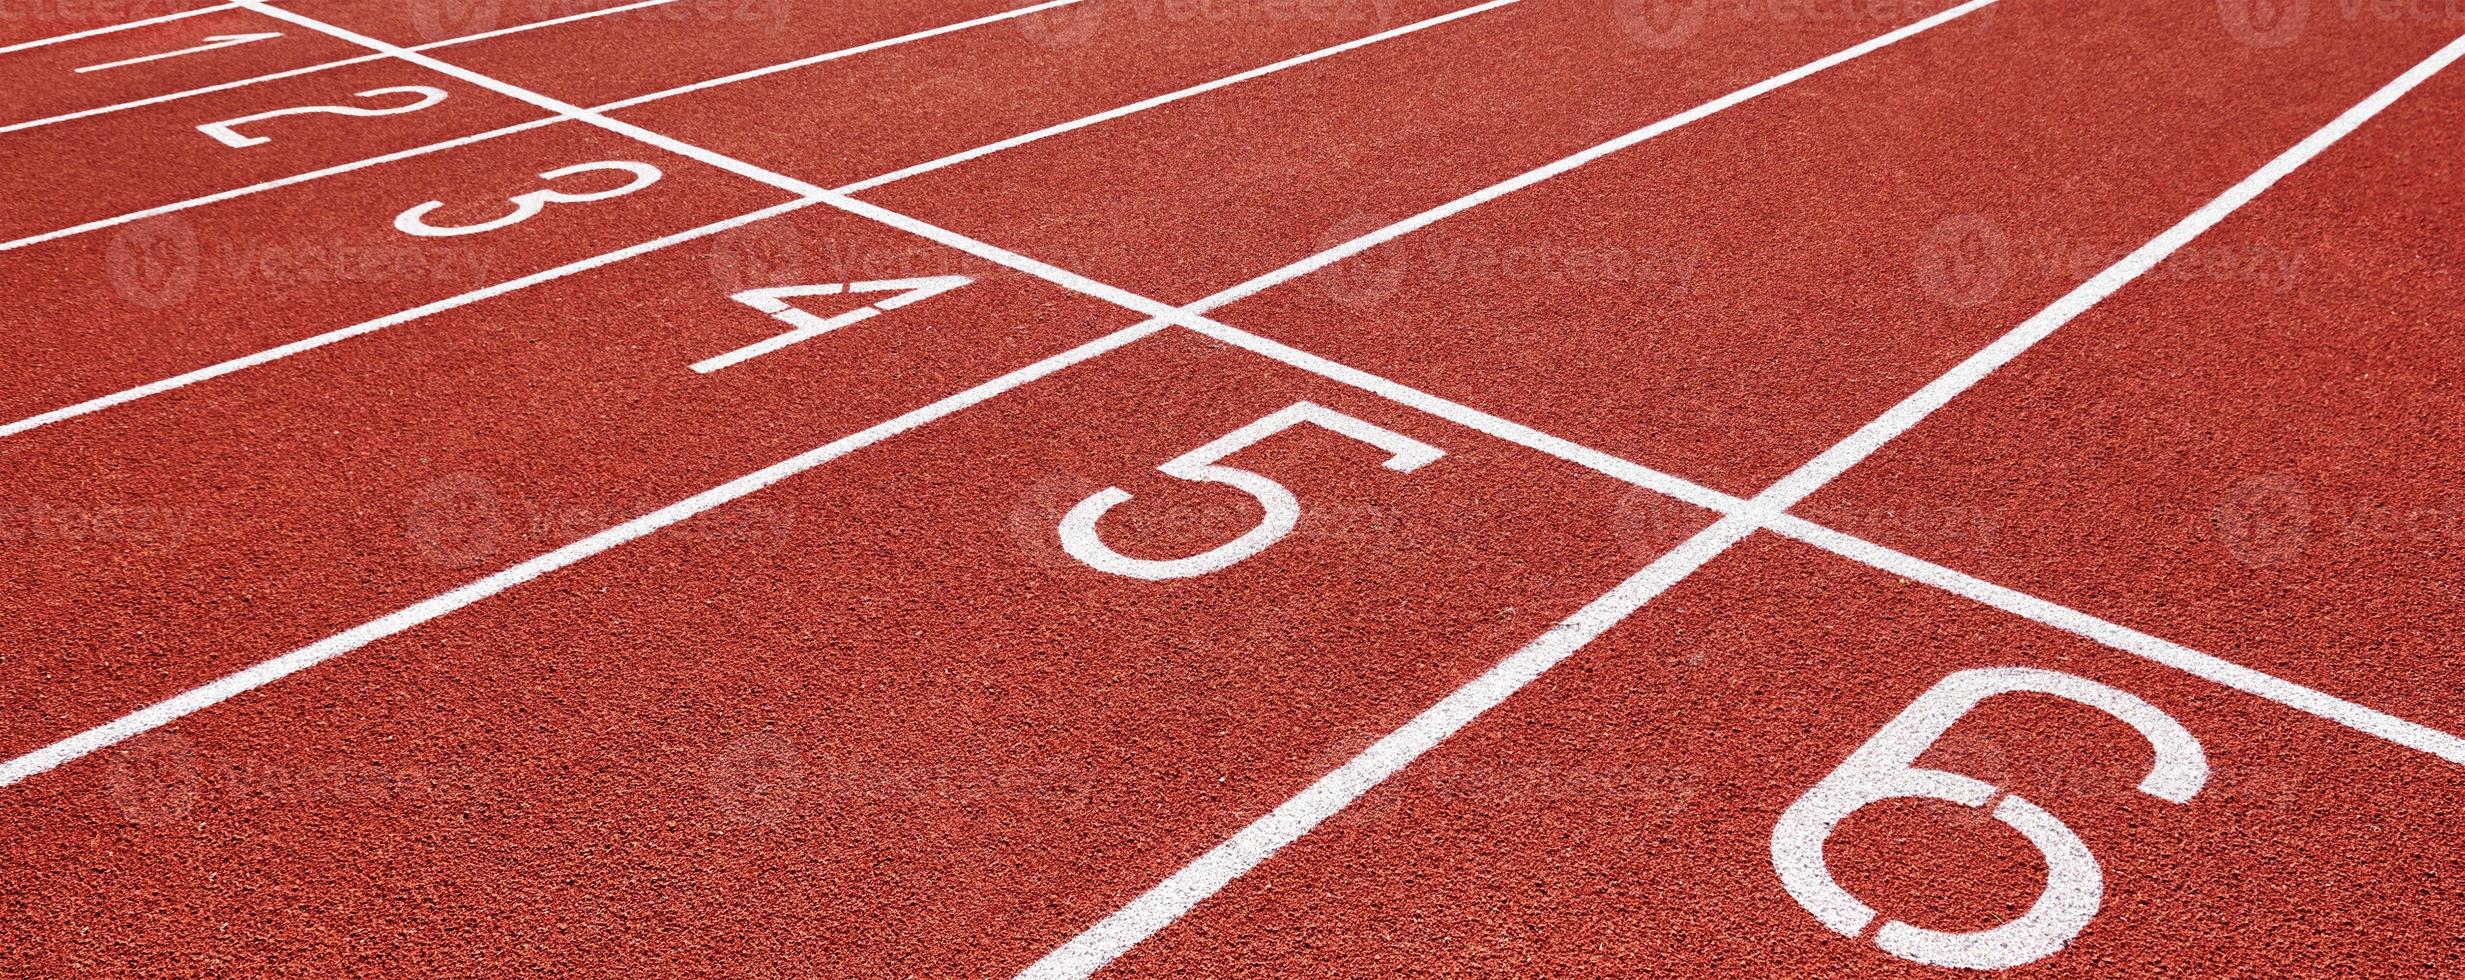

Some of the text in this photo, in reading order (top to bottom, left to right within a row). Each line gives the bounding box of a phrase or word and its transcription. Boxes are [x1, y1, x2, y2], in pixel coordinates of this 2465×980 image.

[74, 31, 284, 74] 1
[195, 85, 449, 149] 2
[393, 160, 663, 237] 3
[688, 274, 976, 374] 4
[1051, 397, 1449, 583] 5
[1768, 664, 2215, 972] 6
